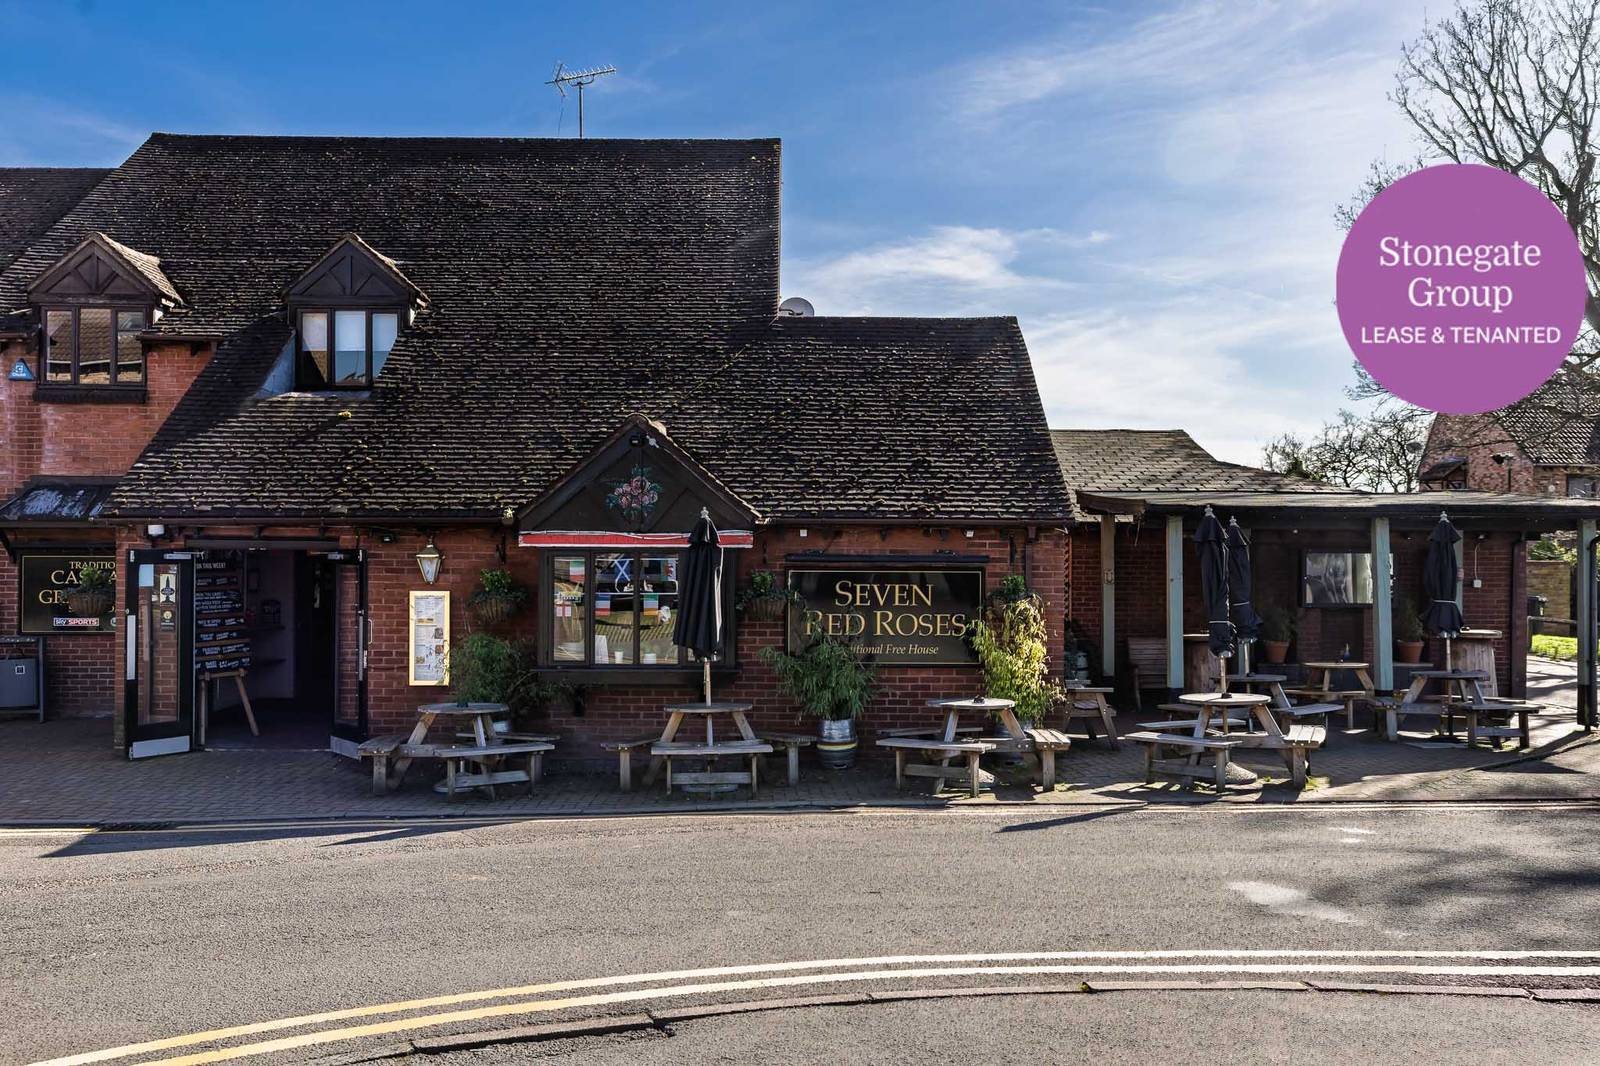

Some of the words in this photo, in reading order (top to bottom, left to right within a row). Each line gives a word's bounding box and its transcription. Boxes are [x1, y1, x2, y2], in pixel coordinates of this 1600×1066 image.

[69, 561, 116, 570] TRADITIO
[805, 610, 866, 636] RED
[885, 643, 906, 655] Free
[908, 643, 939, 655] House
